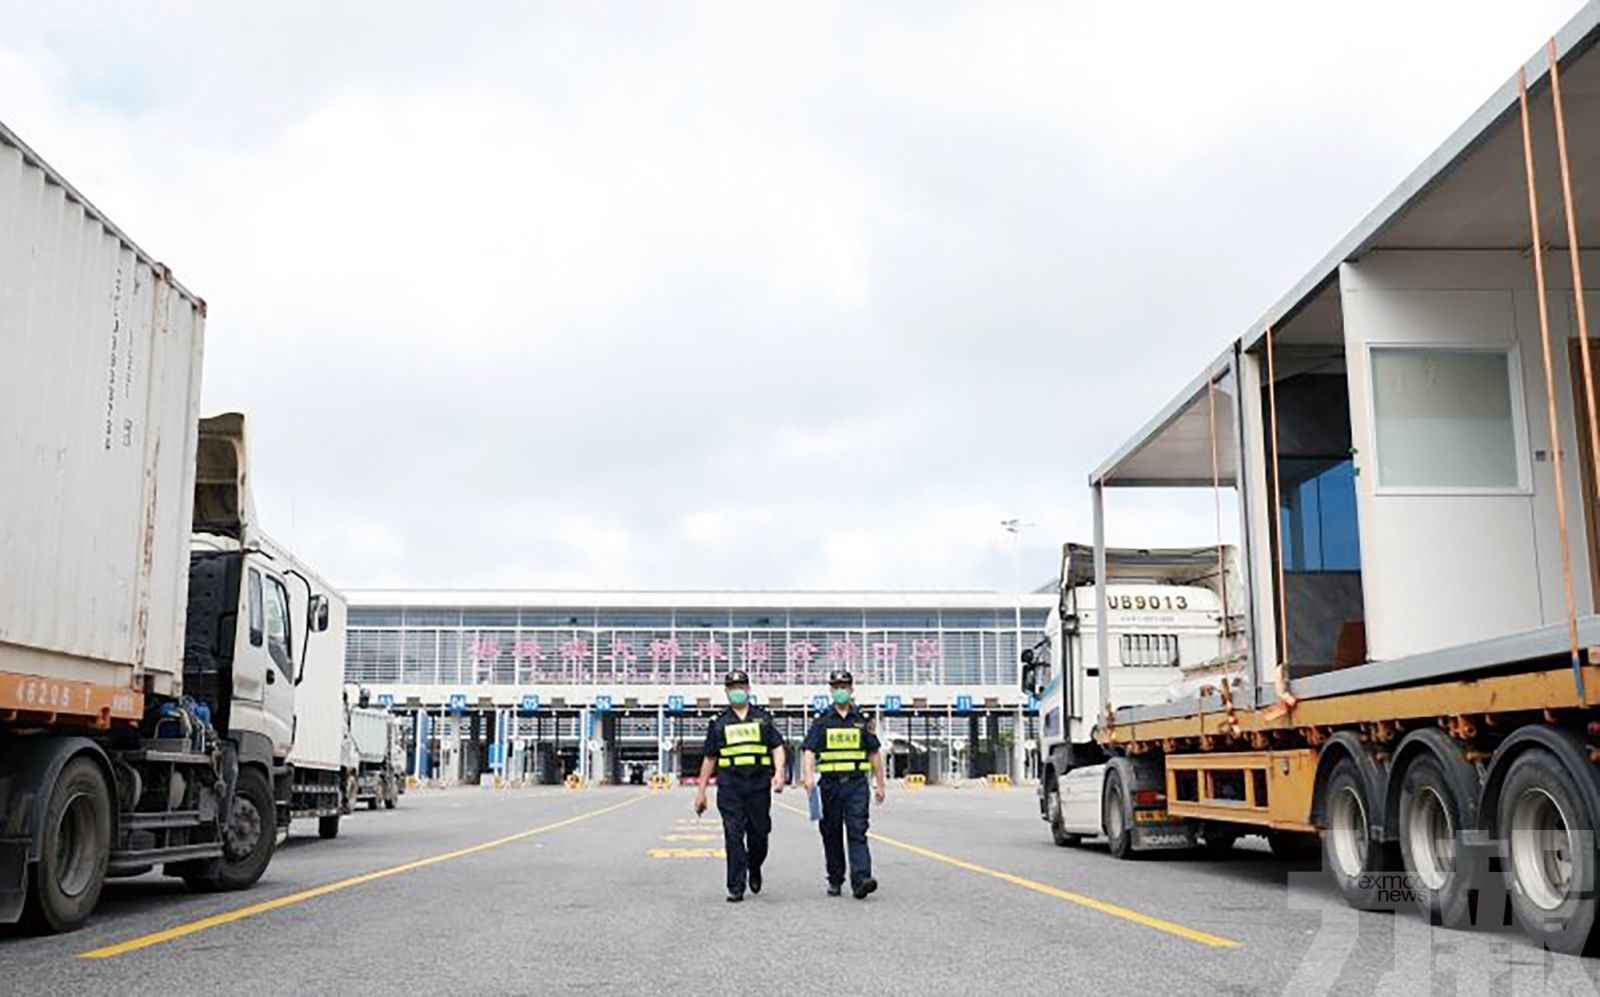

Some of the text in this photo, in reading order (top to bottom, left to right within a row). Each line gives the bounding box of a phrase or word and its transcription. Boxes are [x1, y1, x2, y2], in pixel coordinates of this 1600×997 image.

[1107, 595, 1188, 610] UB9013
[887, 697, 900, 710] 10
[960, 697, 971, 710] 11
